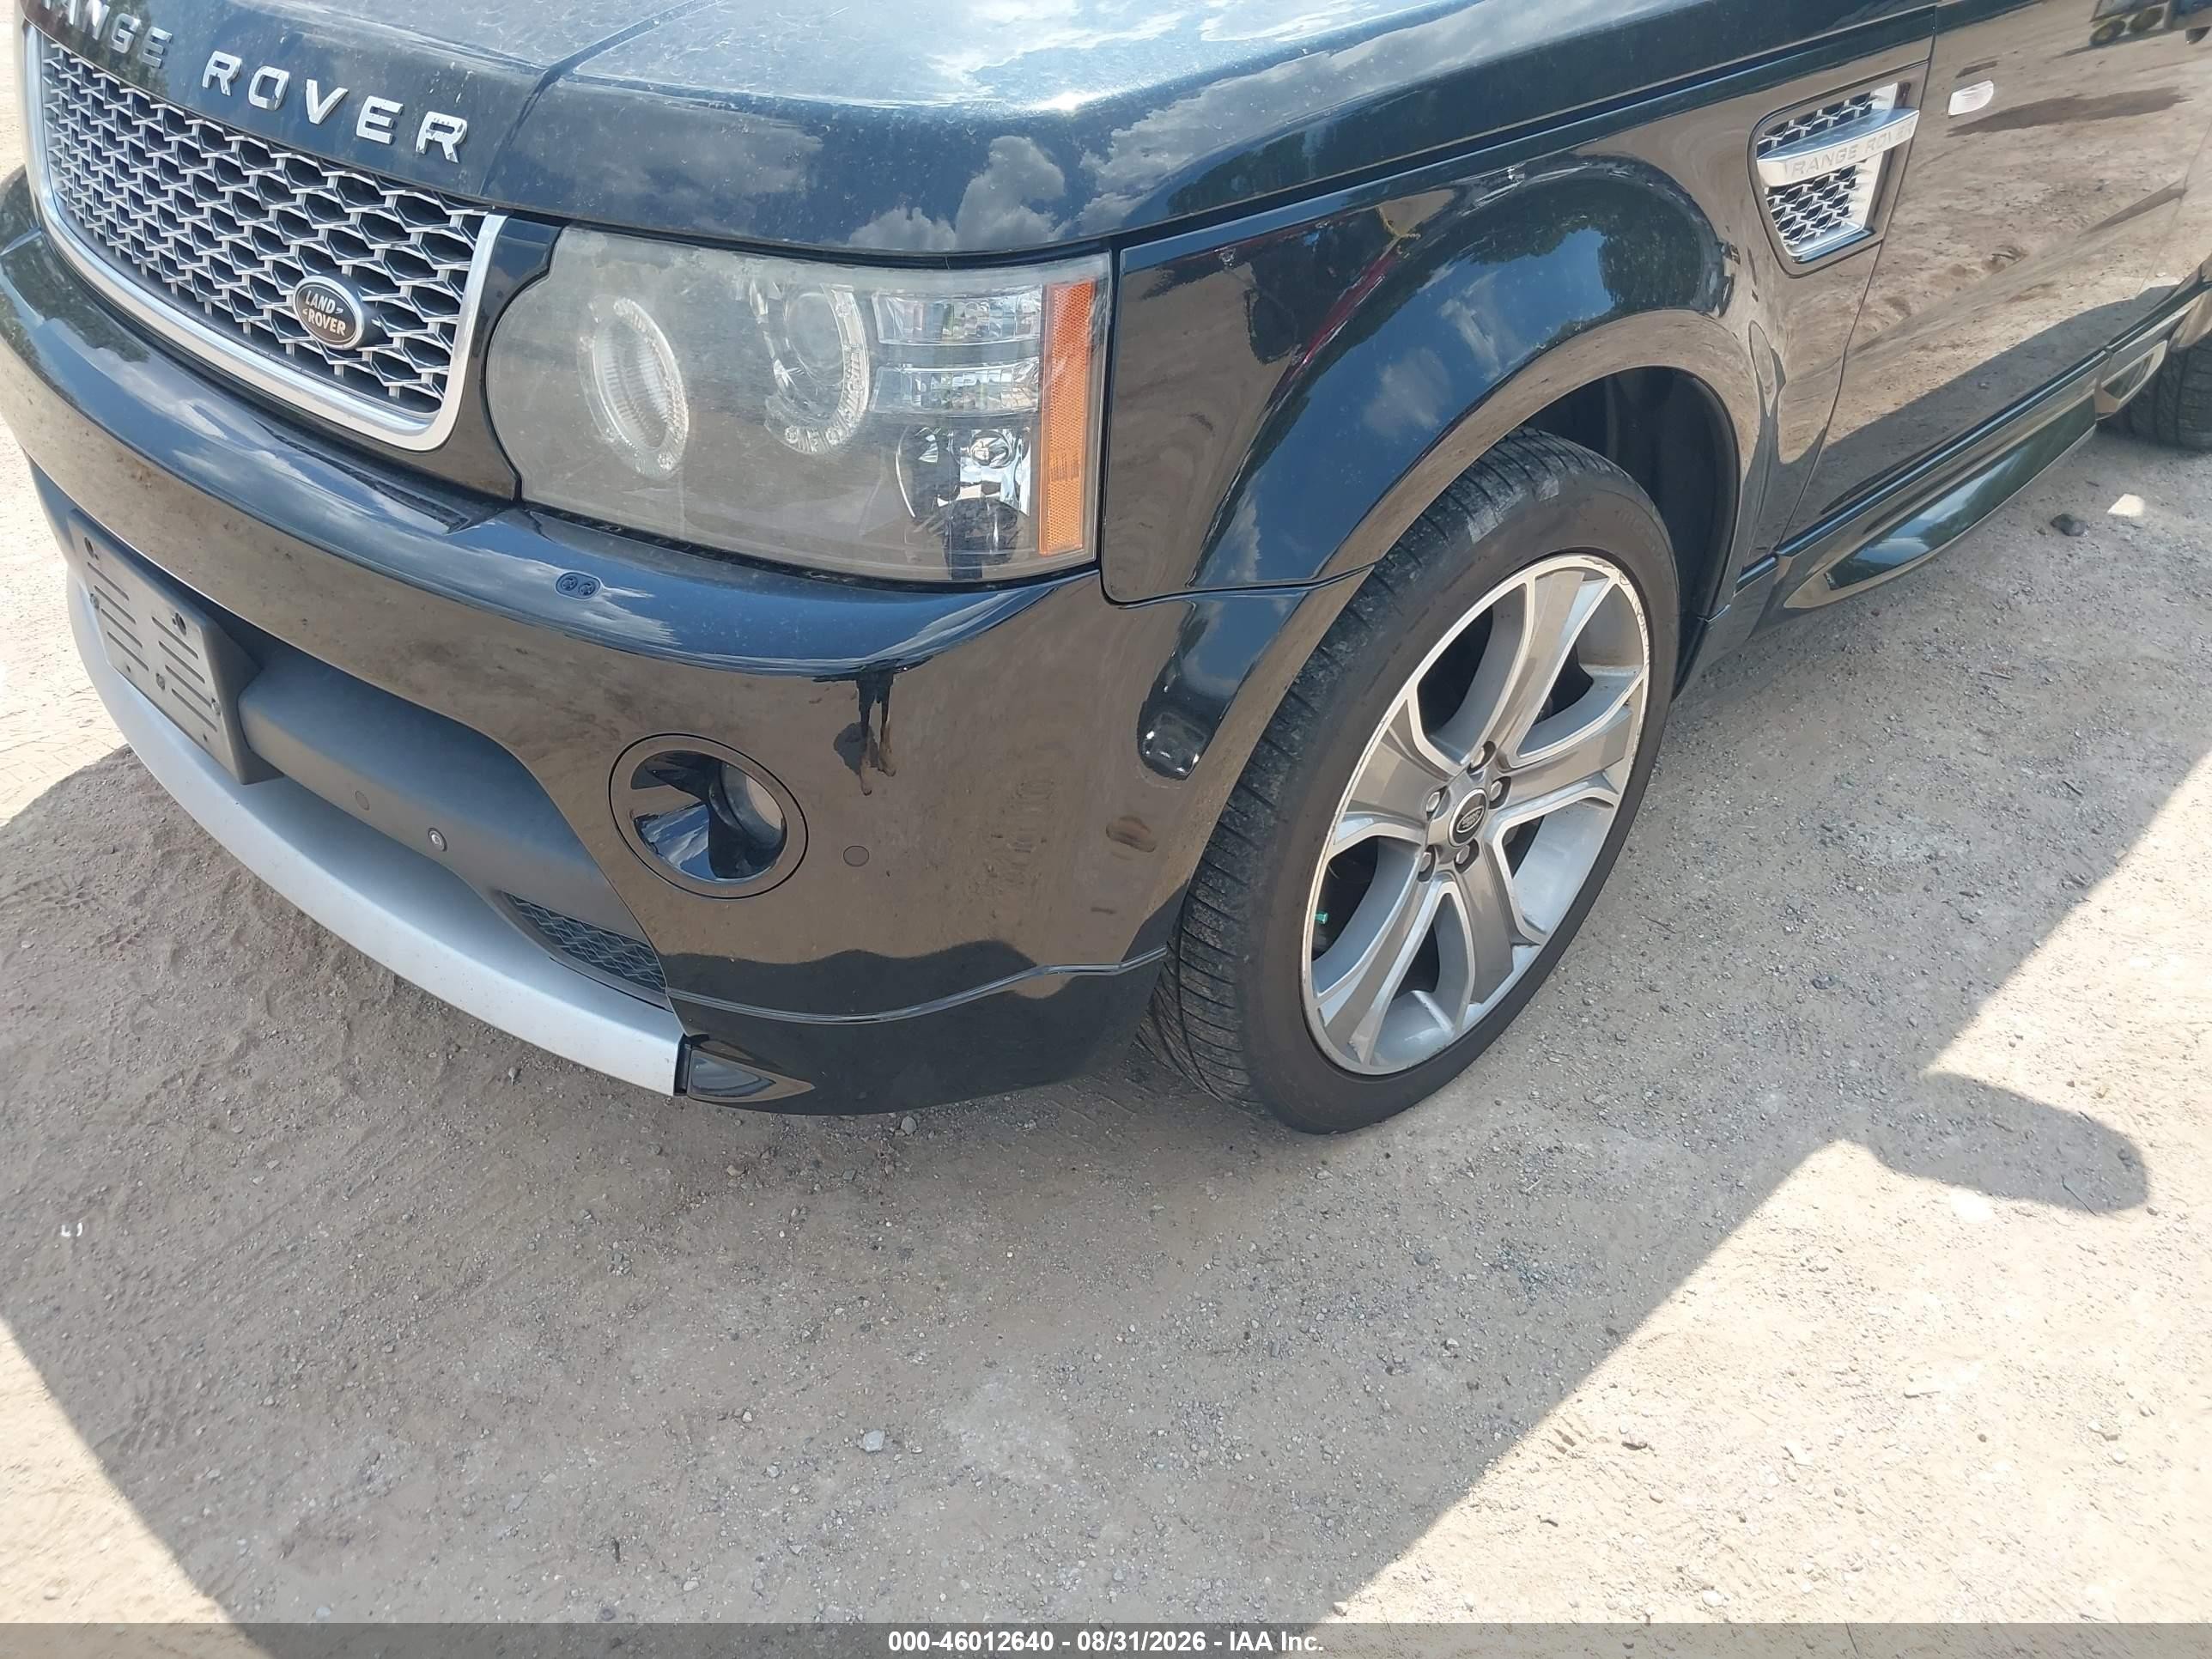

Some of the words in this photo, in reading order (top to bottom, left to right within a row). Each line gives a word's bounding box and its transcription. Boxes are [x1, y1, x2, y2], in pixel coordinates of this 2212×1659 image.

[202, 50, 468, 164] ROVER
[1790, 143, 1859, 177] RANGE
[305, 289, 336, 314] LAND
[307, 310, 346, 337] ROVER
